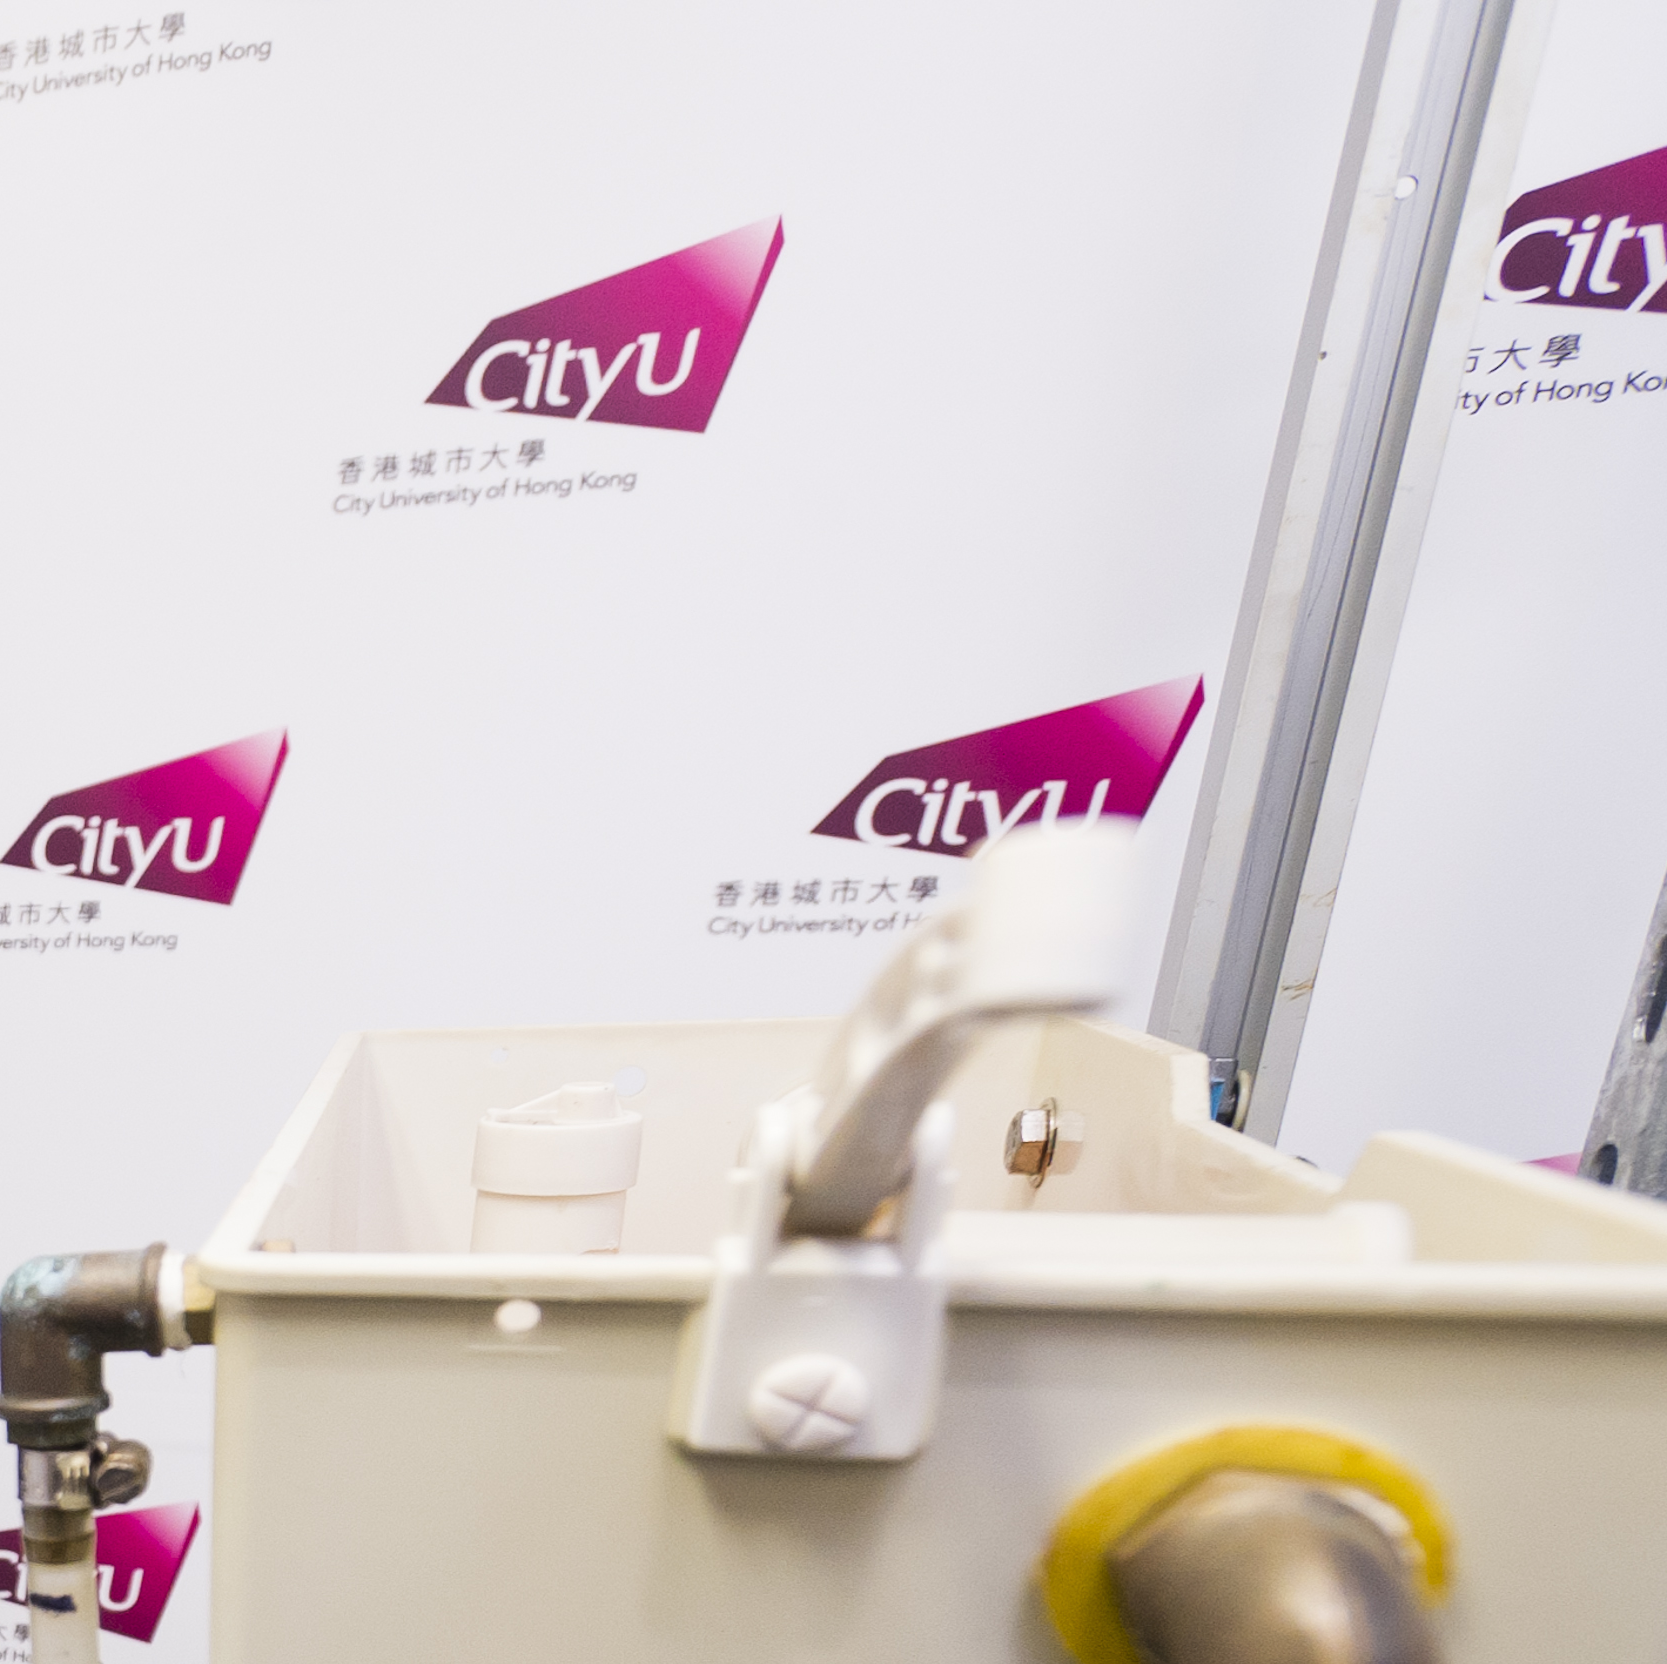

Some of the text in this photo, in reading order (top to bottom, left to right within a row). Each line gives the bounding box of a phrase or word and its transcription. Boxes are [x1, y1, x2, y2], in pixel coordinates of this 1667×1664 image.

[32, 63, 128, 95] University
[130, 53, 154, 78] of
[156, 51, 213, 74] Hong
[217, 41, 273, 63] Kong
[1484, 212, 1667, 312] City
[467, 327, 702, 422] CityU
[1494, 380, 1530, 407] of
[1532, 379, 1615, 404] Hong
[336, 438, 546, 486] 香港城市大學
[332, 470, 637, 517] City University of Hong Kong
[854, 776, 1113, 861] CityU
[34, 814, 226, 889] CityU
[713, 875, 940, 909] 香港城市大學
[52, 930, 73, 950] of
[75, 932, 125, 953] Hong
[130, 930, 179, 952] Kong
[707, 916, 754, 940] City
[757, 913, 870, 938] University
[872, 910, 900, 932] of
